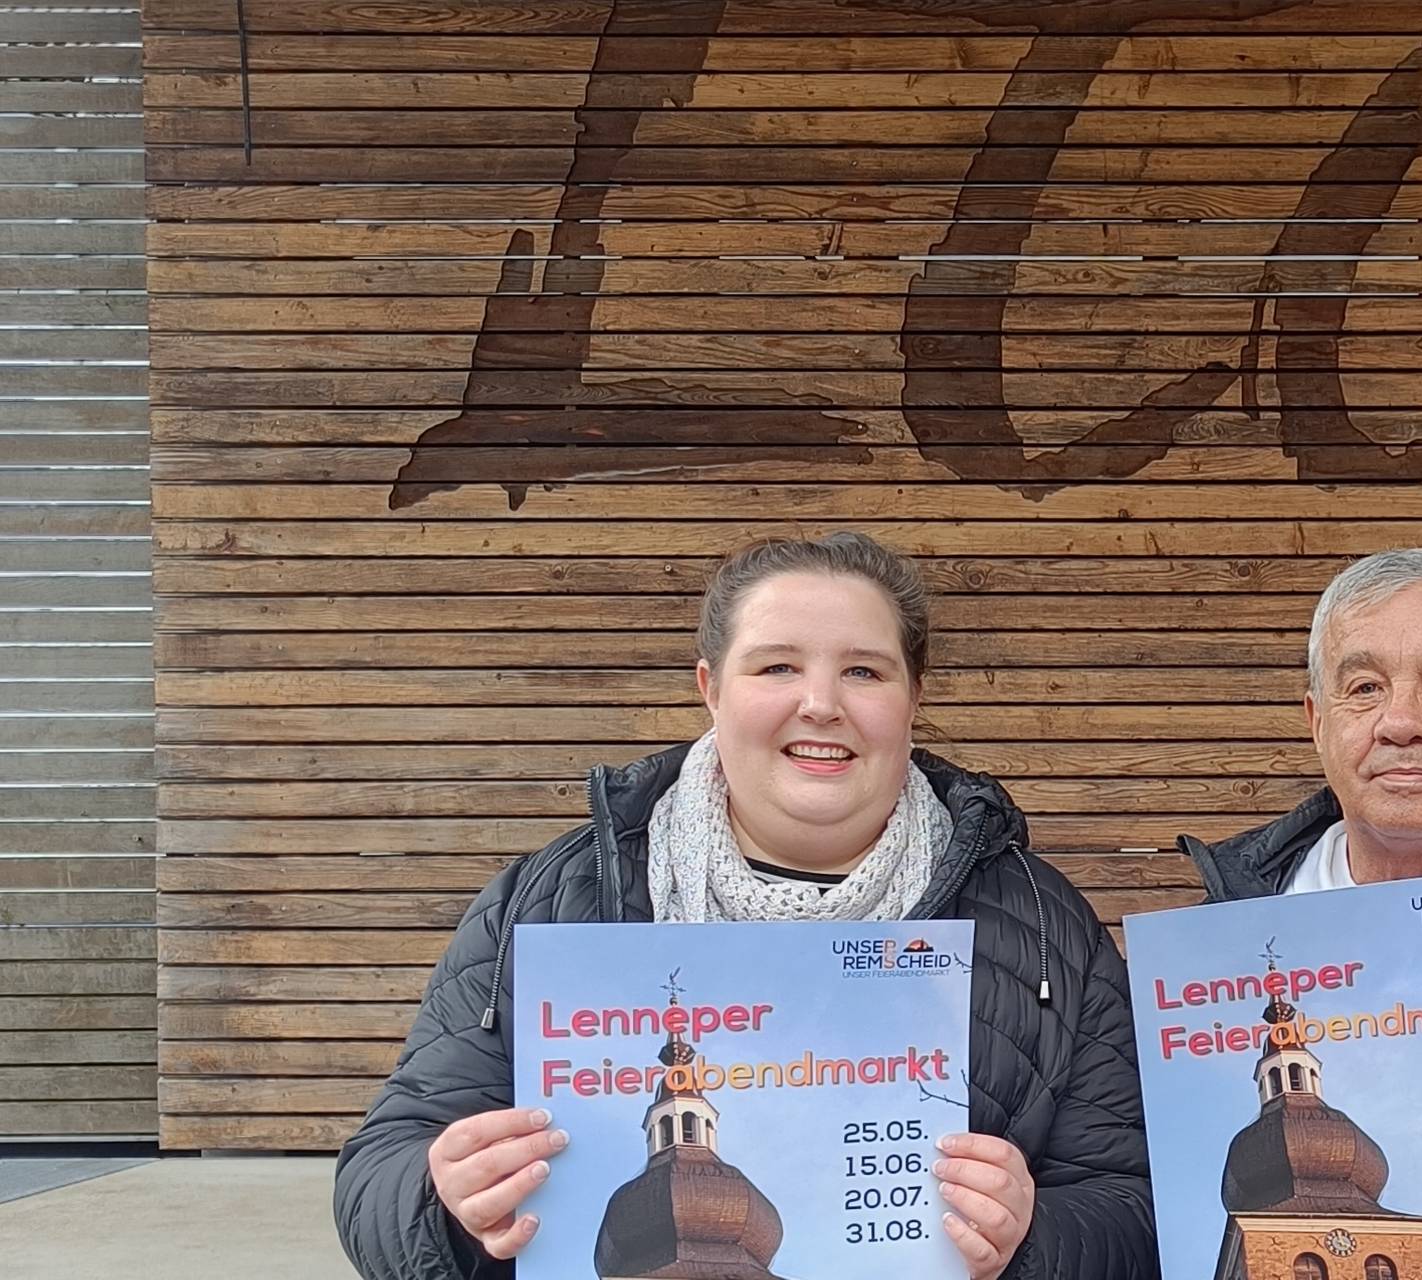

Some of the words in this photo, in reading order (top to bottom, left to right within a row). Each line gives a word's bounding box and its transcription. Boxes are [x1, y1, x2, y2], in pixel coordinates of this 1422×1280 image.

[842, 954, 952, 970] REMSCHEID
[1153, 959, 1365, 1010] Lenneper
[541, 1001, 773, 1041] Lenneper
[541, 1046, 950, 1098] Feierabendmarkt
[842, 1119, 930, 1144] 25.05.
[844, 1153, 930, 1178] 15.06.
[843, 1186, 930, 1211] 20.07.
[844, 1220, 931, 1244] 31.08.
